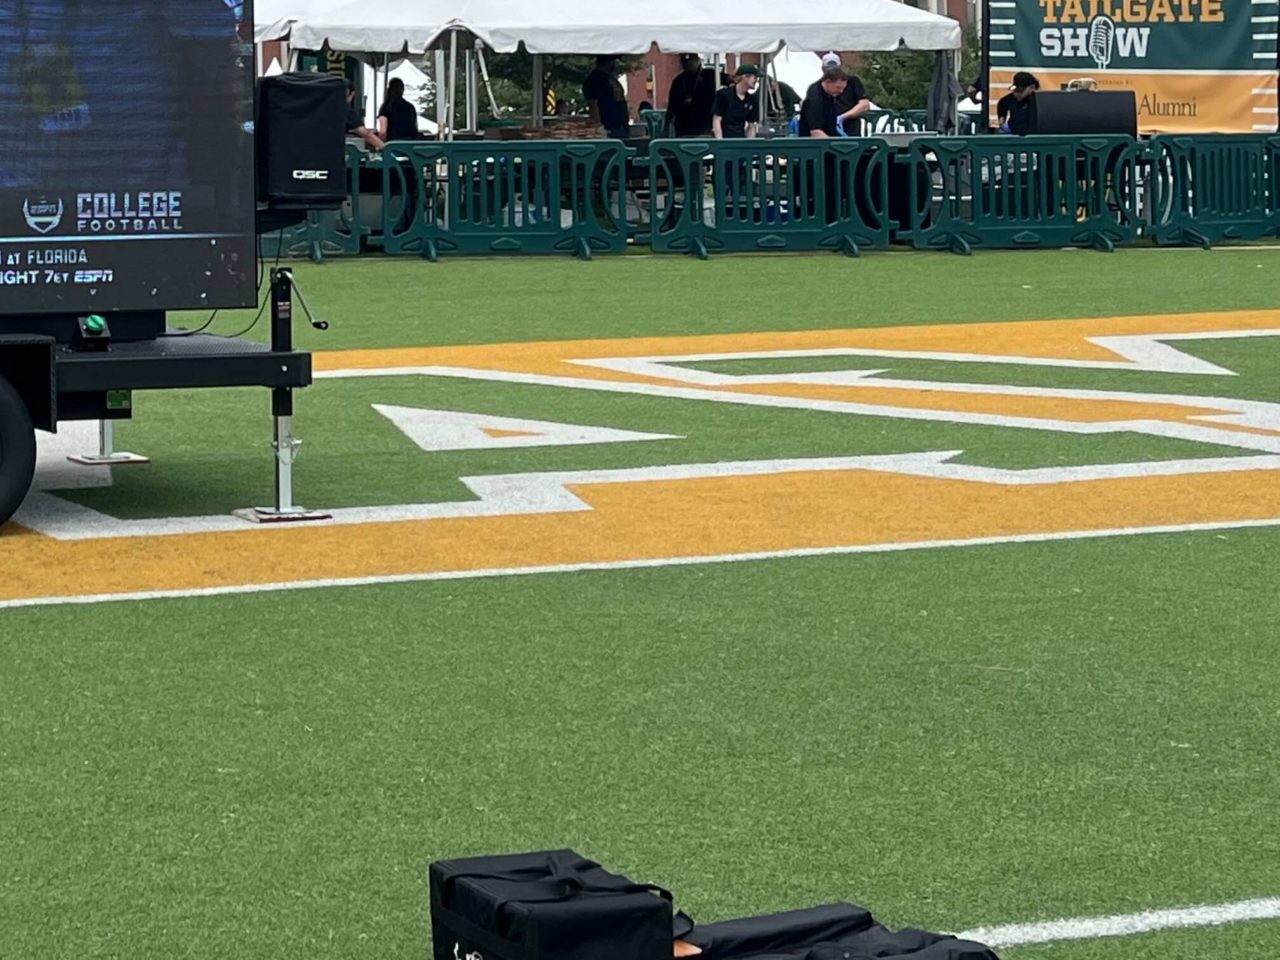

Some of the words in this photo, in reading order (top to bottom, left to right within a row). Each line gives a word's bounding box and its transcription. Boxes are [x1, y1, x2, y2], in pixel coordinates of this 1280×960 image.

[1138, 93, 1197, 117] Alumni
[292, 170, 328, 179] QSC
[77, 191, 182, 218] COLLEGE
[77, 219, 183, 231] FOOTBALL
[7, 253, 21, 265] AT
[27, 249, 88, 264] FLORIDA
[74, 270, 113, 282] ESPN
